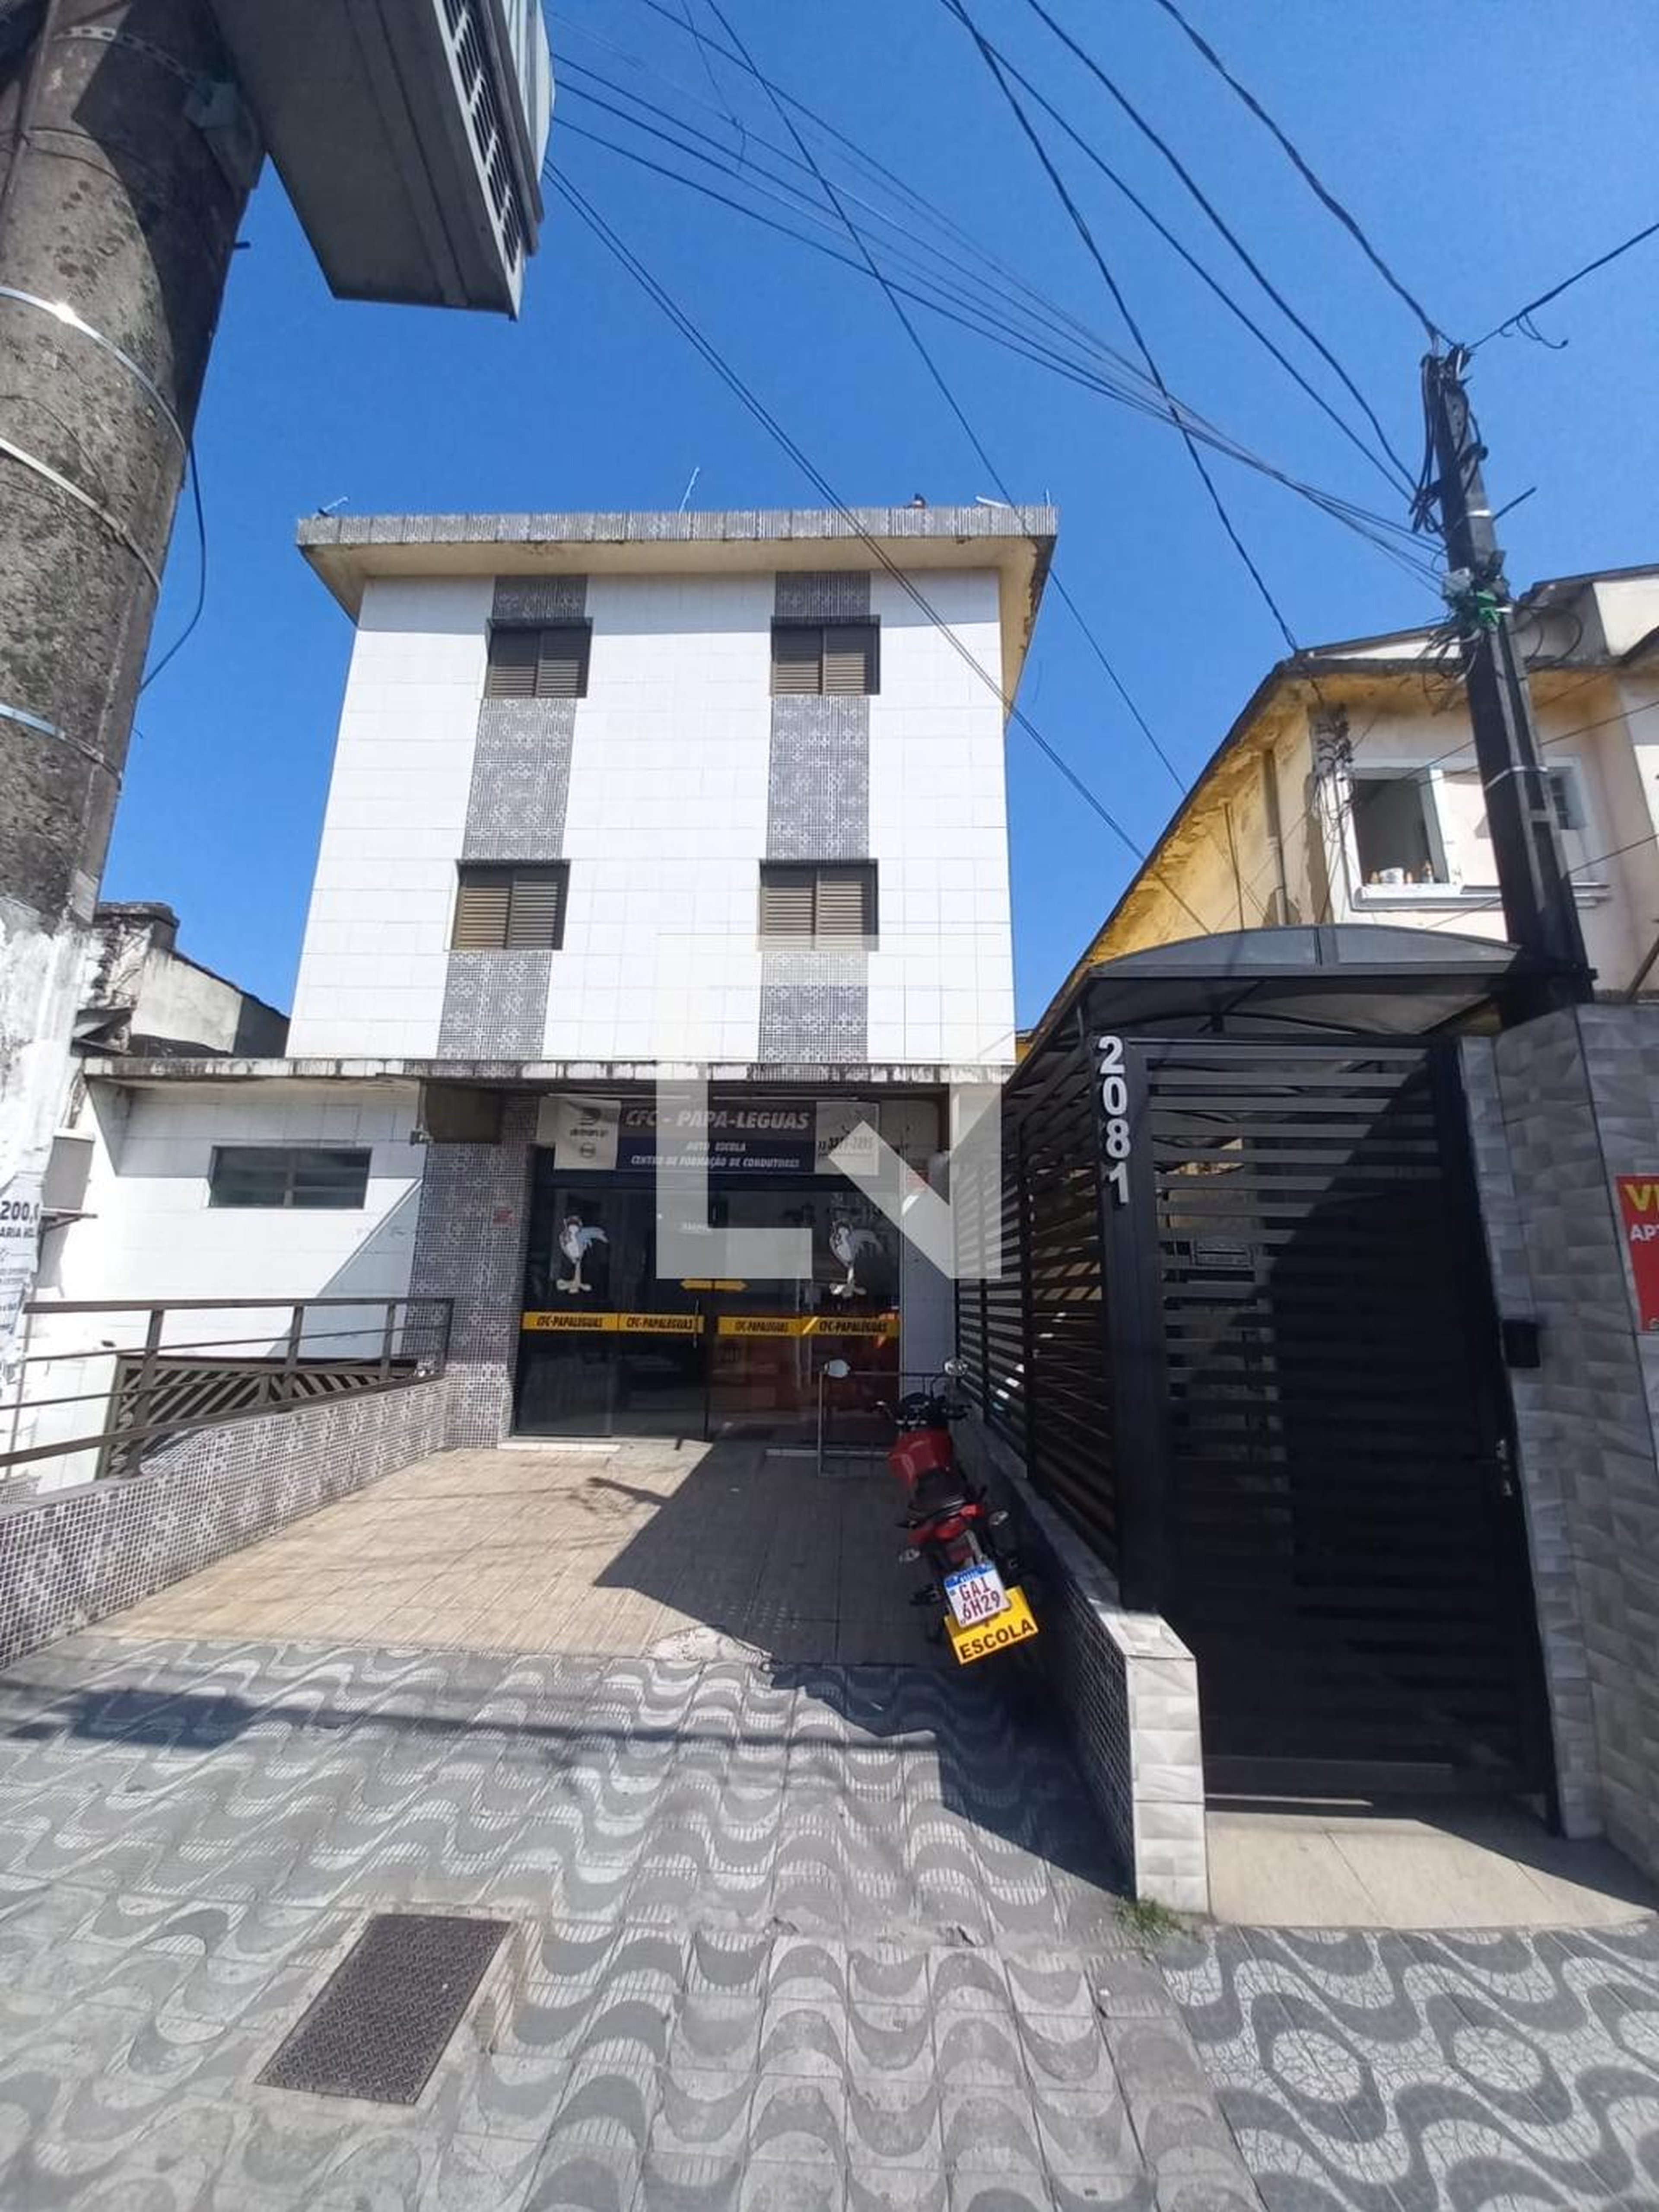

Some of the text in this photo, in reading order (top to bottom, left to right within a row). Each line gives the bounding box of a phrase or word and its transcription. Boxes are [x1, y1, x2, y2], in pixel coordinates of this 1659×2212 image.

[677, 1110, 810, 1129] PAPA-LEGUAS
[1098, 1035, 1131, 1204] 2081
[715, 1142, 746, 1152] ESCOLA
[962, 1590, 1001, 1620] 6H29
[959, 1618, 1034, 1660] ESCOLA
